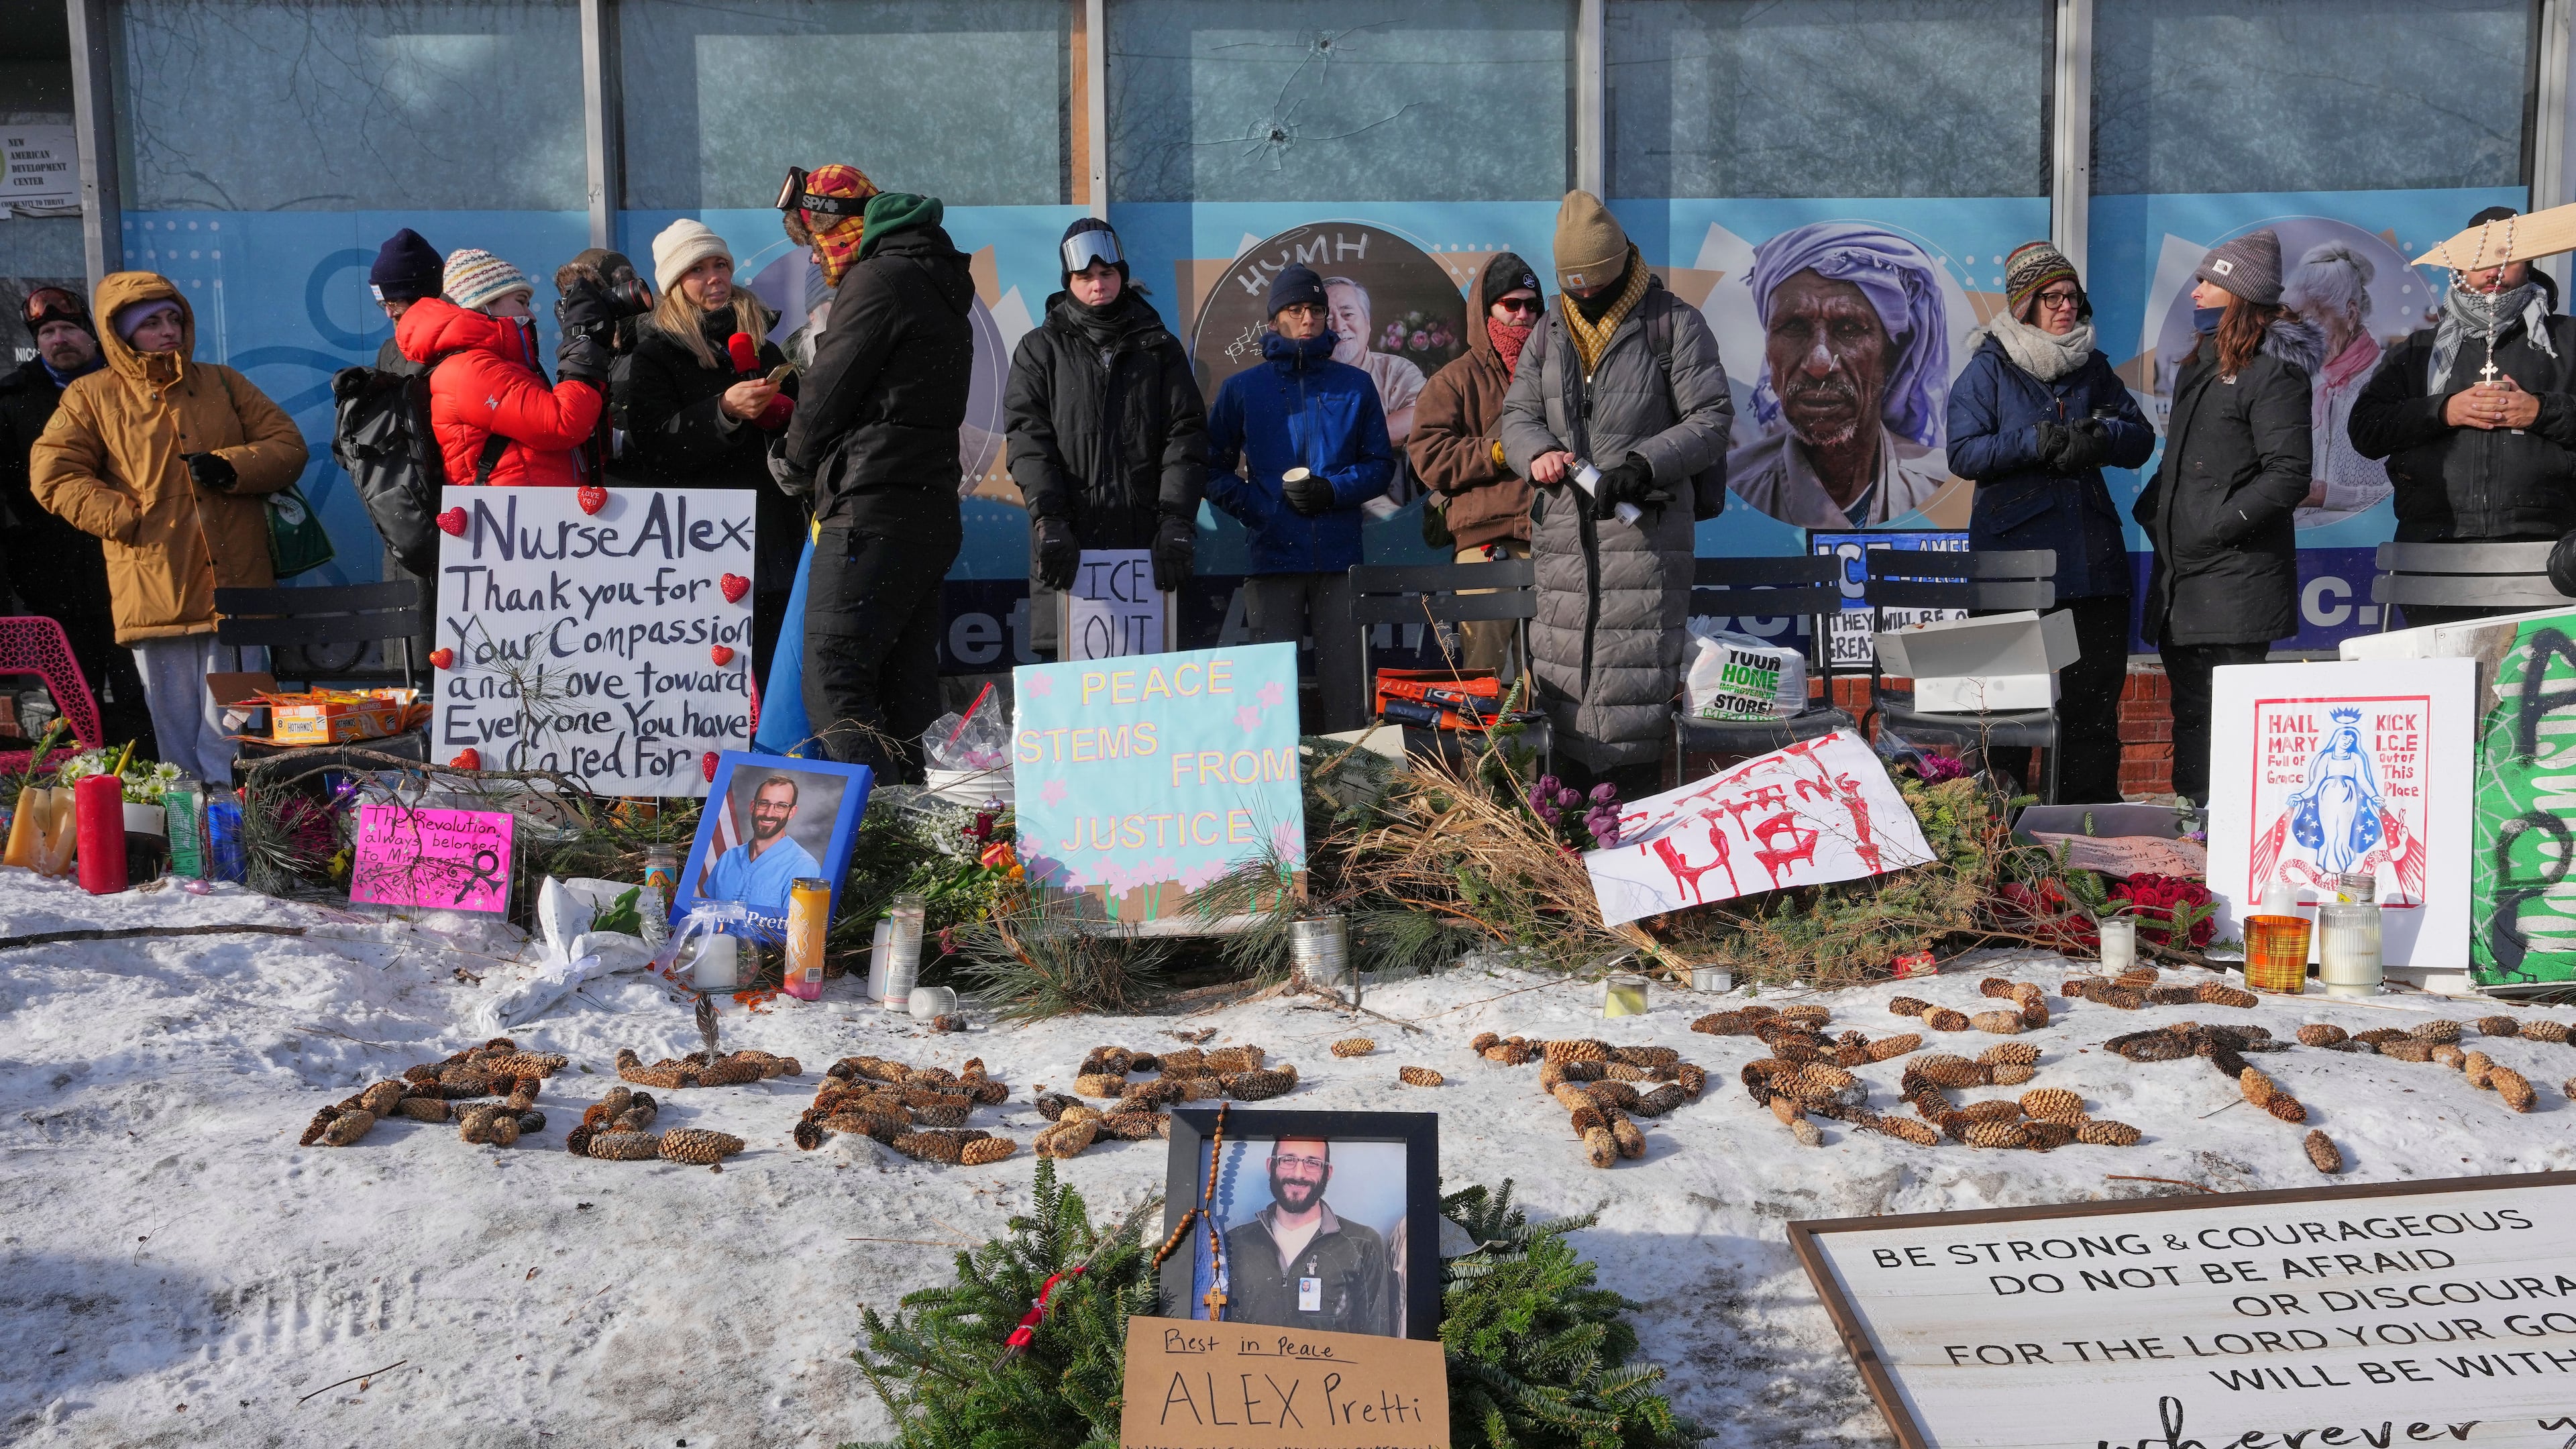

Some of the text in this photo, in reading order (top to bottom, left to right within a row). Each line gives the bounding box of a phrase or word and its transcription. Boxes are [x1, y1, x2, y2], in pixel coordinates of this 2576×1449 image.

[8, 138, 24, 147] NEW
[10, 150, 50, 160] AMERICAN
[11, 162, 67, 173] DEVELOPMENT
[13, 176, 44, 186] CENTER
[581, 490, 600, 499] LOVE
[582, 497, 597, 505] YOU
[472, 495, 628, 561] Nurse
[1083, 559, 1148, 603] ICE
[445, 566, 711, 621] Thank you for
[1830, 612, 1874, 632] THEY
[1882, 610, 1913, 632] WILL
[447, 614, 753, 667] Your Compassion
[1084, 614, 1153, 660] OUT
[1729, 649, 1782, 672] YOUR
[447, 665, 522, 699] and
[635, 655, 749, 698] toward
[1081, 659, 1234, 706] PEACE
[1721, 663, 1780, 692] HOME
[1719, 682, 1776, 700] IMPROVEMENT
[346, 702, 382, 712] HAND WARMERS
[1714, 694, 1774, 715] STORE!
[278, 720, 283, 728] 8
[288, 721, 313, 733] HOTHANDS
[335, 717, 356, 729] HOTHANDS
[445, 699, 749, 749] Everyone You have
[2269, 714, 2320, 733] HAIL
[2375, 713, 2418, 731] KICK
[1017, 722, 1159, 764] STEMS
[2268, 736, 2320, 753] MARY
[506, 731, 691, 779] Cared For
[2267, 755, 2290, 767] Full
[1172, 746, 1296, 788] FROM
[2267, 769, 2304, 784] Grace
[2381, 764, 2414, 780] This
[2384, 781, 2420, 797] Place
[366, 807, 496, 834] The Revolution
[1061, 808, 1254, 852] JUSTICE
[362, 849, 378, 861] to
[365, 830, 500, 858] always belonged
[1872, 1209, 2534, 1269] BE STRONG & COURAGEOUS
[1989, 1248, 2456, 1295] DO NOT BE AFRAID
[2232, 1293, 2310, 1316] OR
[1165, 1328, 1220, 1352] Rest
[1240, 1336, 1260, 1352] in
[1944, 1342, 2054, 1367] FOR
[2062, 1336, 2176, 1362] THE
[2182, 1328, 2328, 1357] LORD
[2335, 1318, 2497, 1347] YOUR
[2208, 1348, 2576, 1392] WILL BE WITH
[1161, 1371, 1422, 1429] ALEX Pretti
